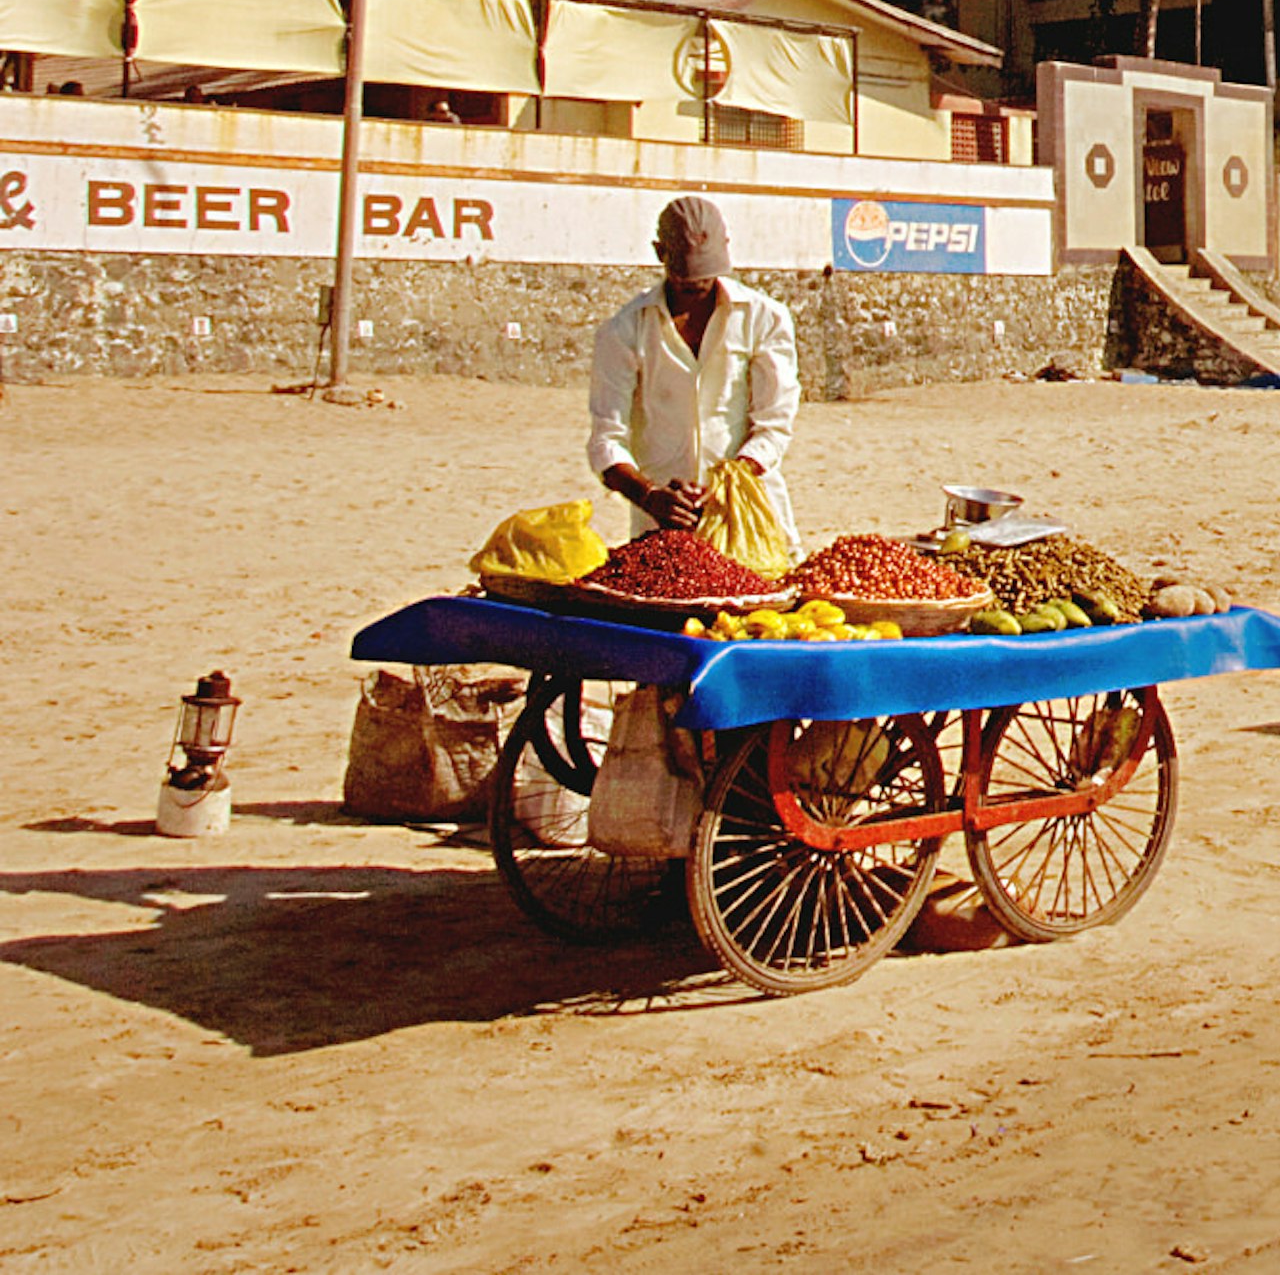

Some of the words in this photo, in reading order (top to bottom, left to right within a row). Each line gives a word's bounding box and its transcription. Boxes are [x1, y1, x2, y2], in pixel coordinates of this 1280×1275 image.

[0, 171, 36, 230] &
[87, 180, 290, 233] BEER
[362, 193, 494, 241] BAR
[884, 220, 979, 253] PEPSI
